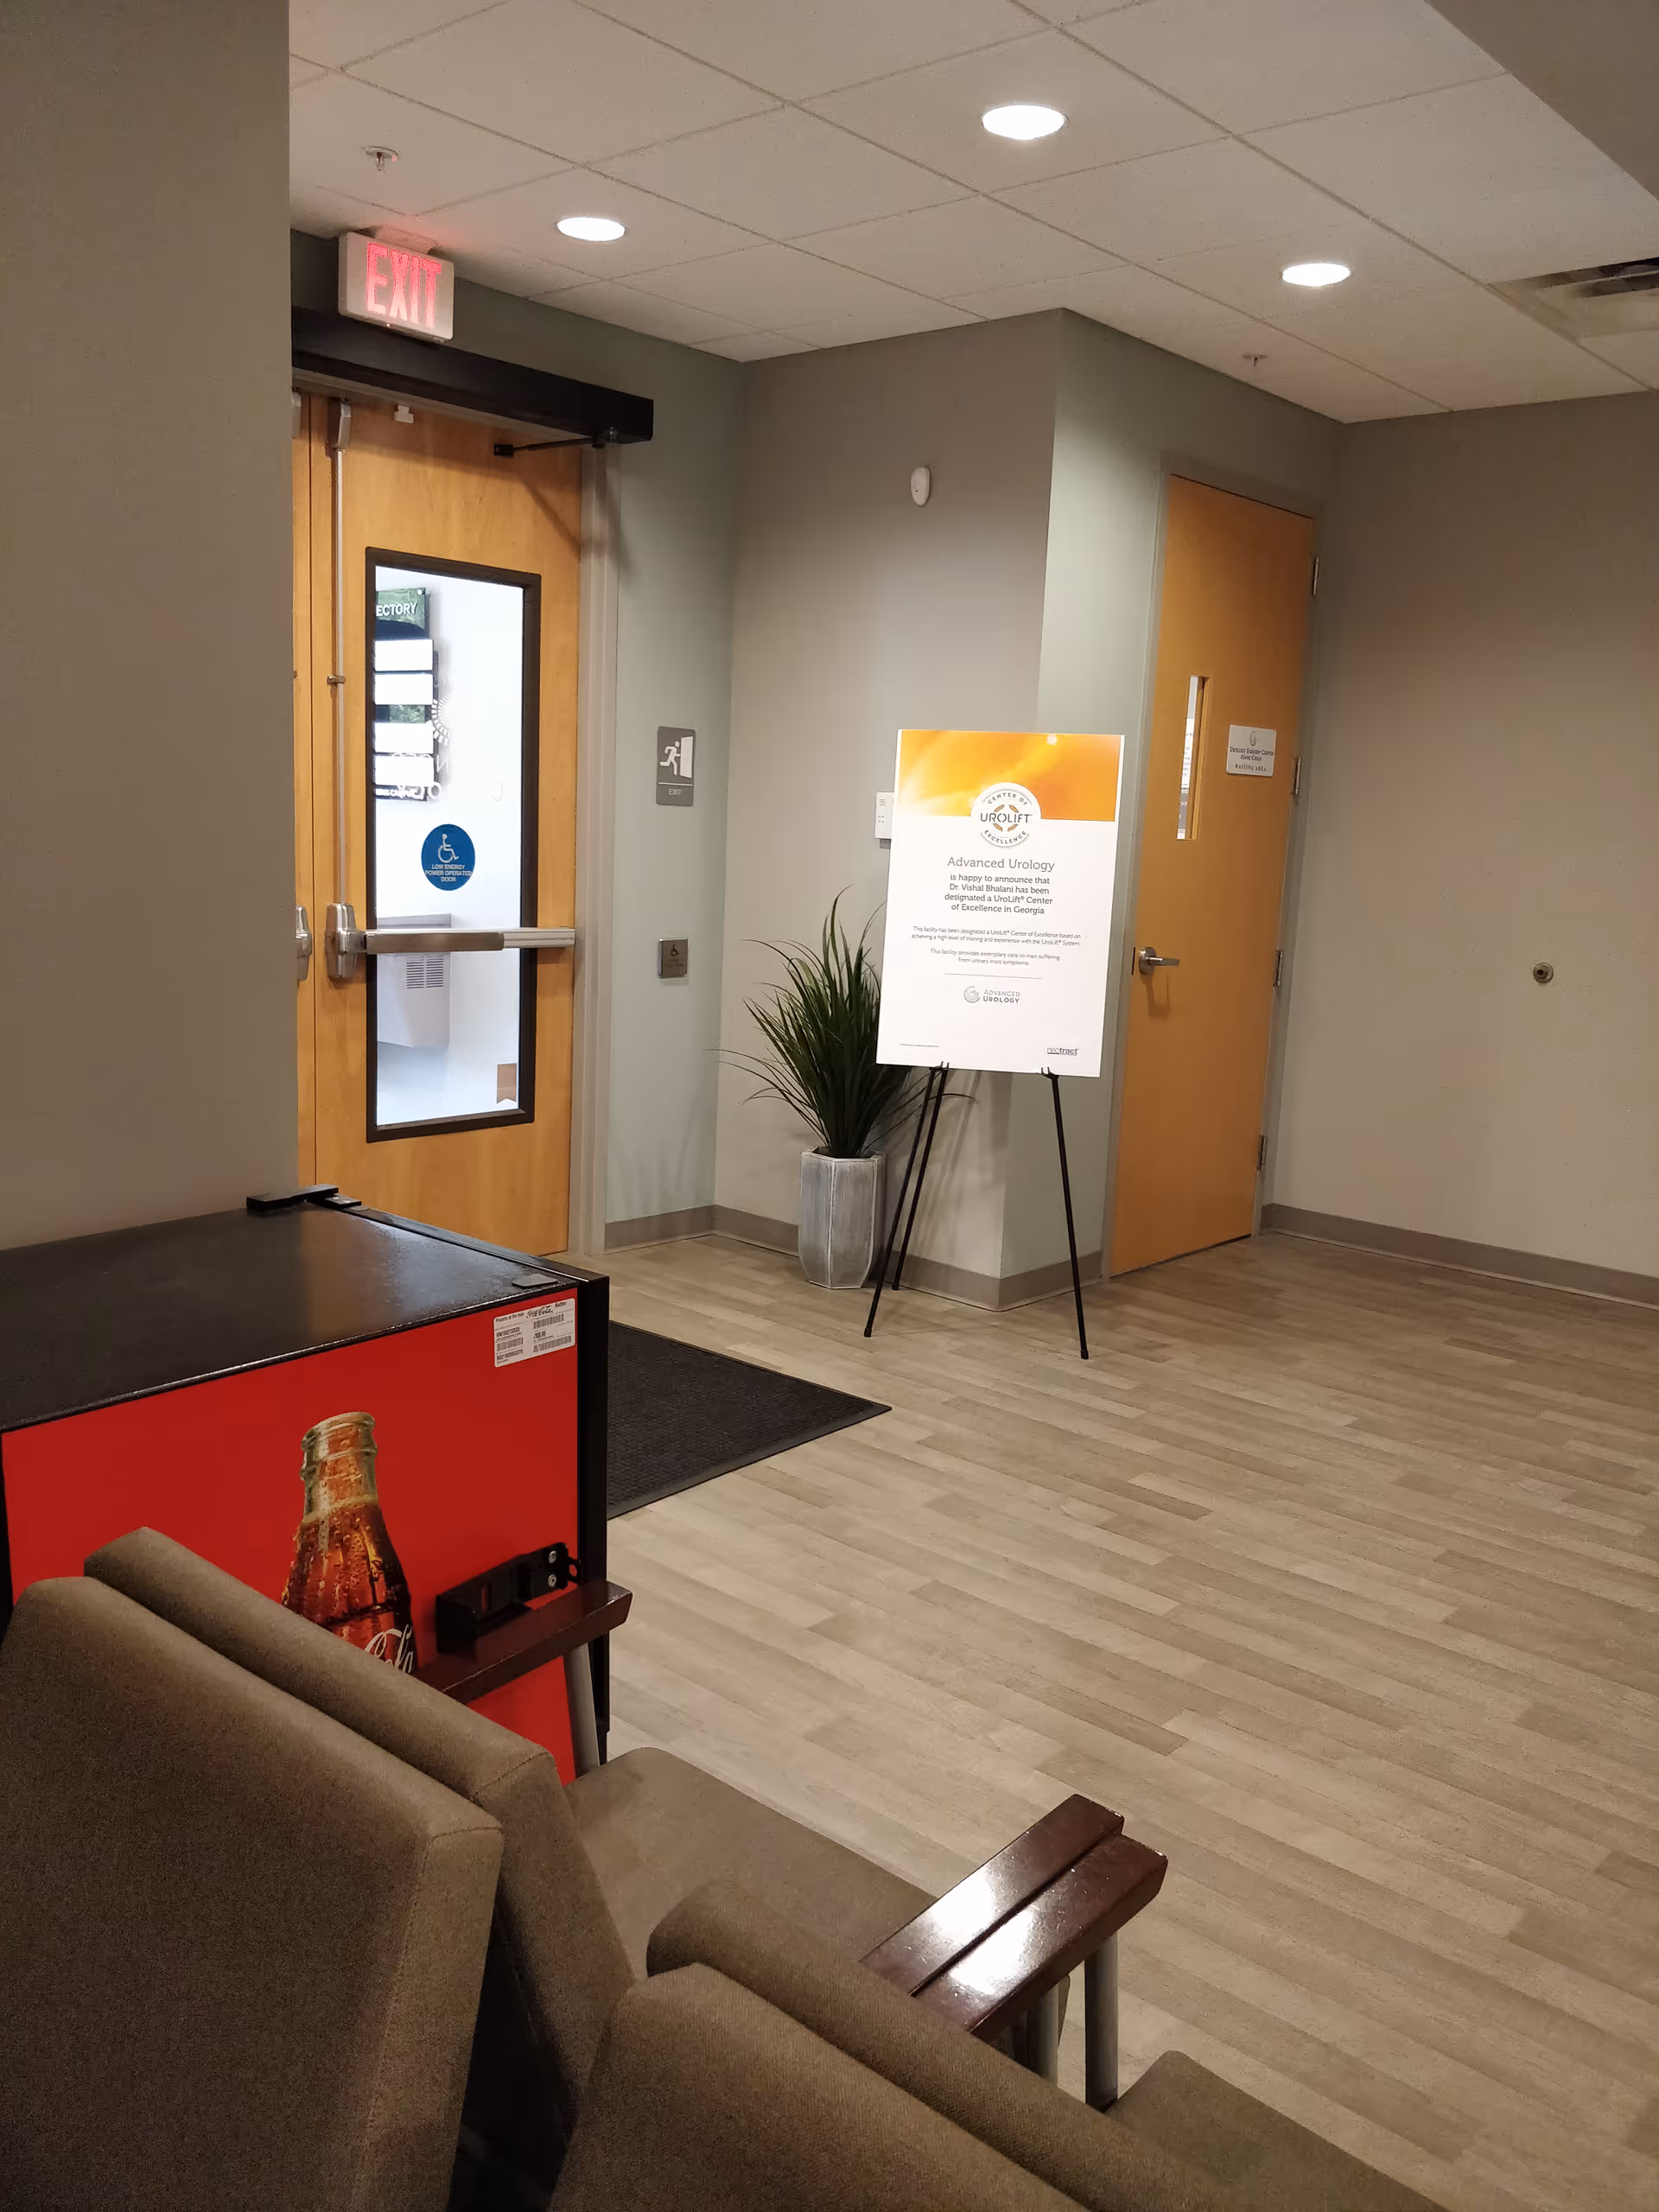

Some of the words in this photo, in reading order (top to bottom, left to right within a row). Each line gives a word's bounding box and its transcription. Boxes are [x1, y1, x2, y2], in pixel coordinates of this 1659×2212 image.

[367, 242, 442, 330] EXIT
[988, 792, 1017, 804] CENTER
[984, 830, 1027, 844] EXCELLENCE
[947, 857, 1005, 868] Advanced
[1008, 859, 1055, 873] Urology
[958, 874, 982, 883] happy
[944, 893, 986, 902] designated
[961, 904, 1002, 912] Excellence
[1014, 906, 1045, 915] Georgia
[983, 988, 1020, 997] ADVANCED
